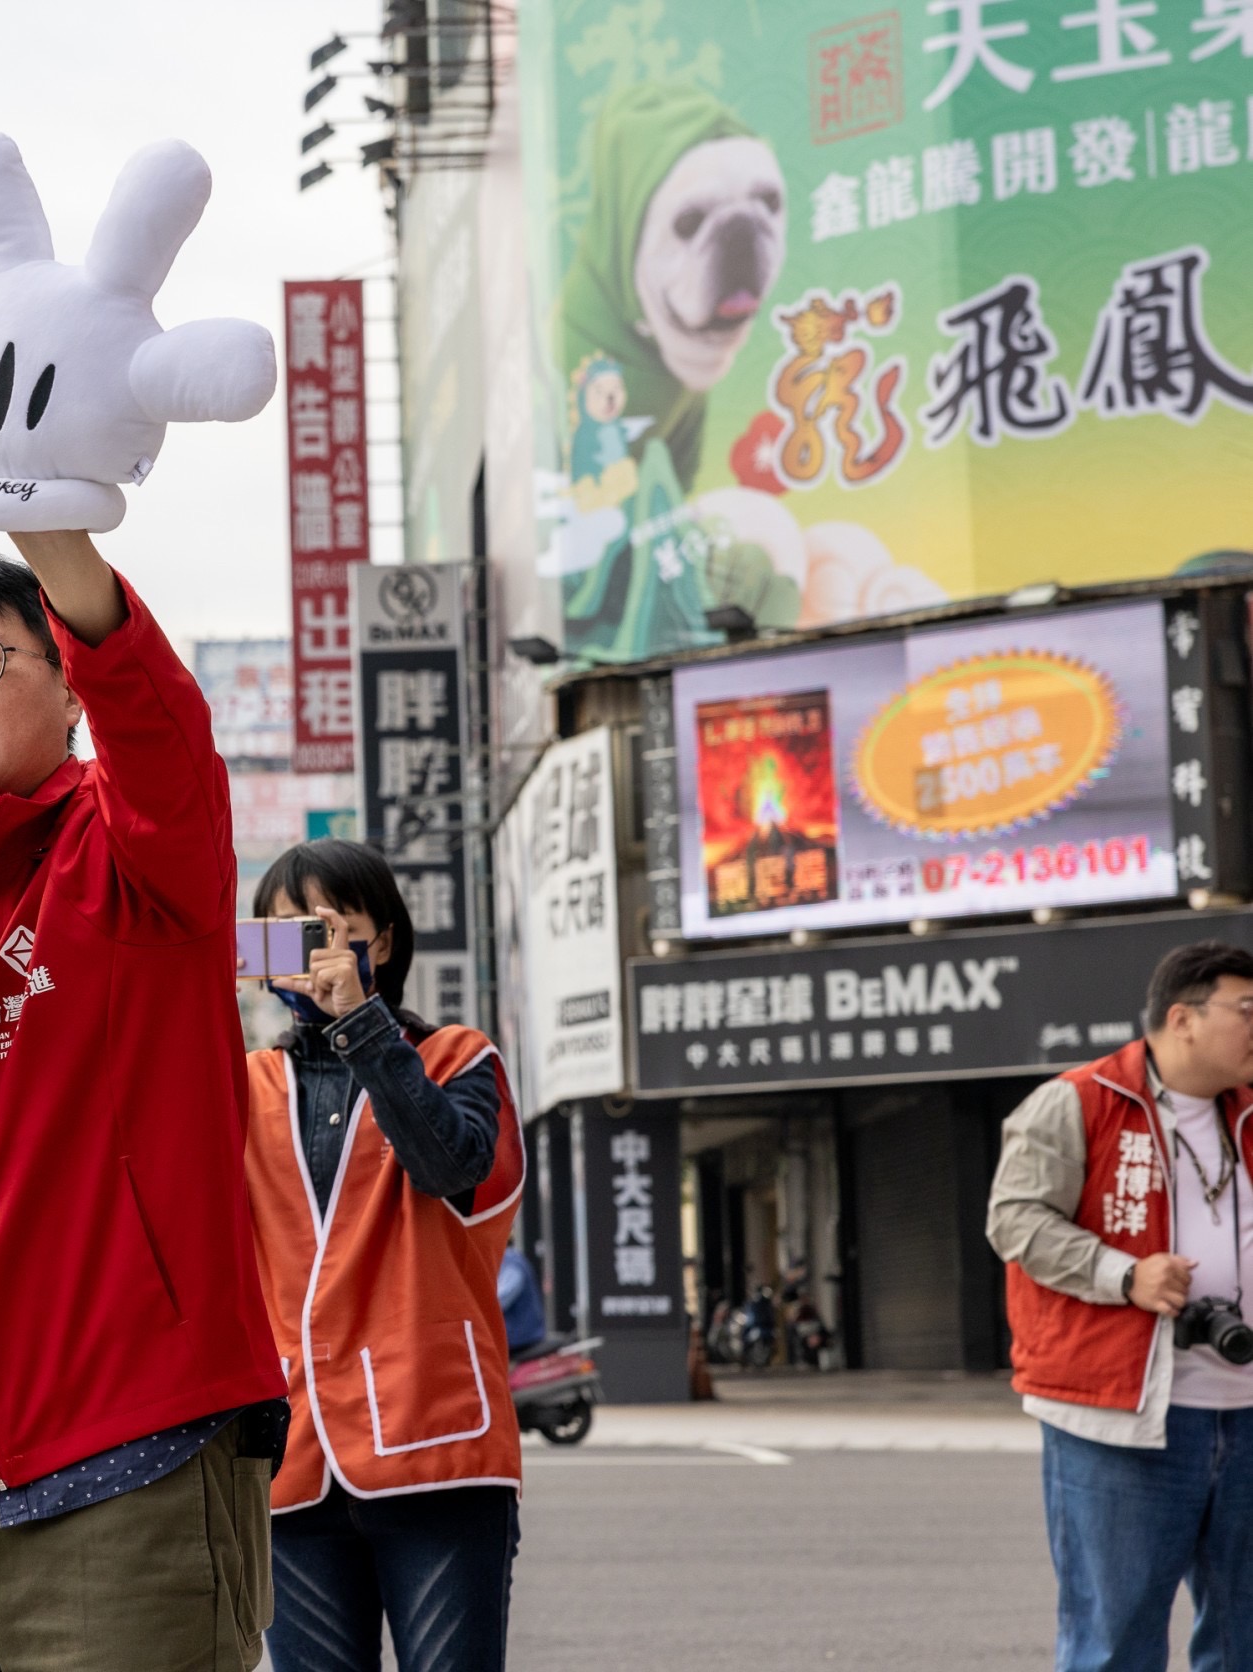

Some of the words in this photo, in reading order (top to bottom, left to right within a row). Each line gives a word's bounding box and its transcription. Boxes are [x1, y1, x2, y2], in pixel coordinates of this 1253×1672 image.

[809, 115, 1137, 242] 鑫龍騰開發
[1165, 96, 1253, 176] 龍
[299, 594, 354, 737] 出租
[639, 973, 813, 1035] 胖胖星球
